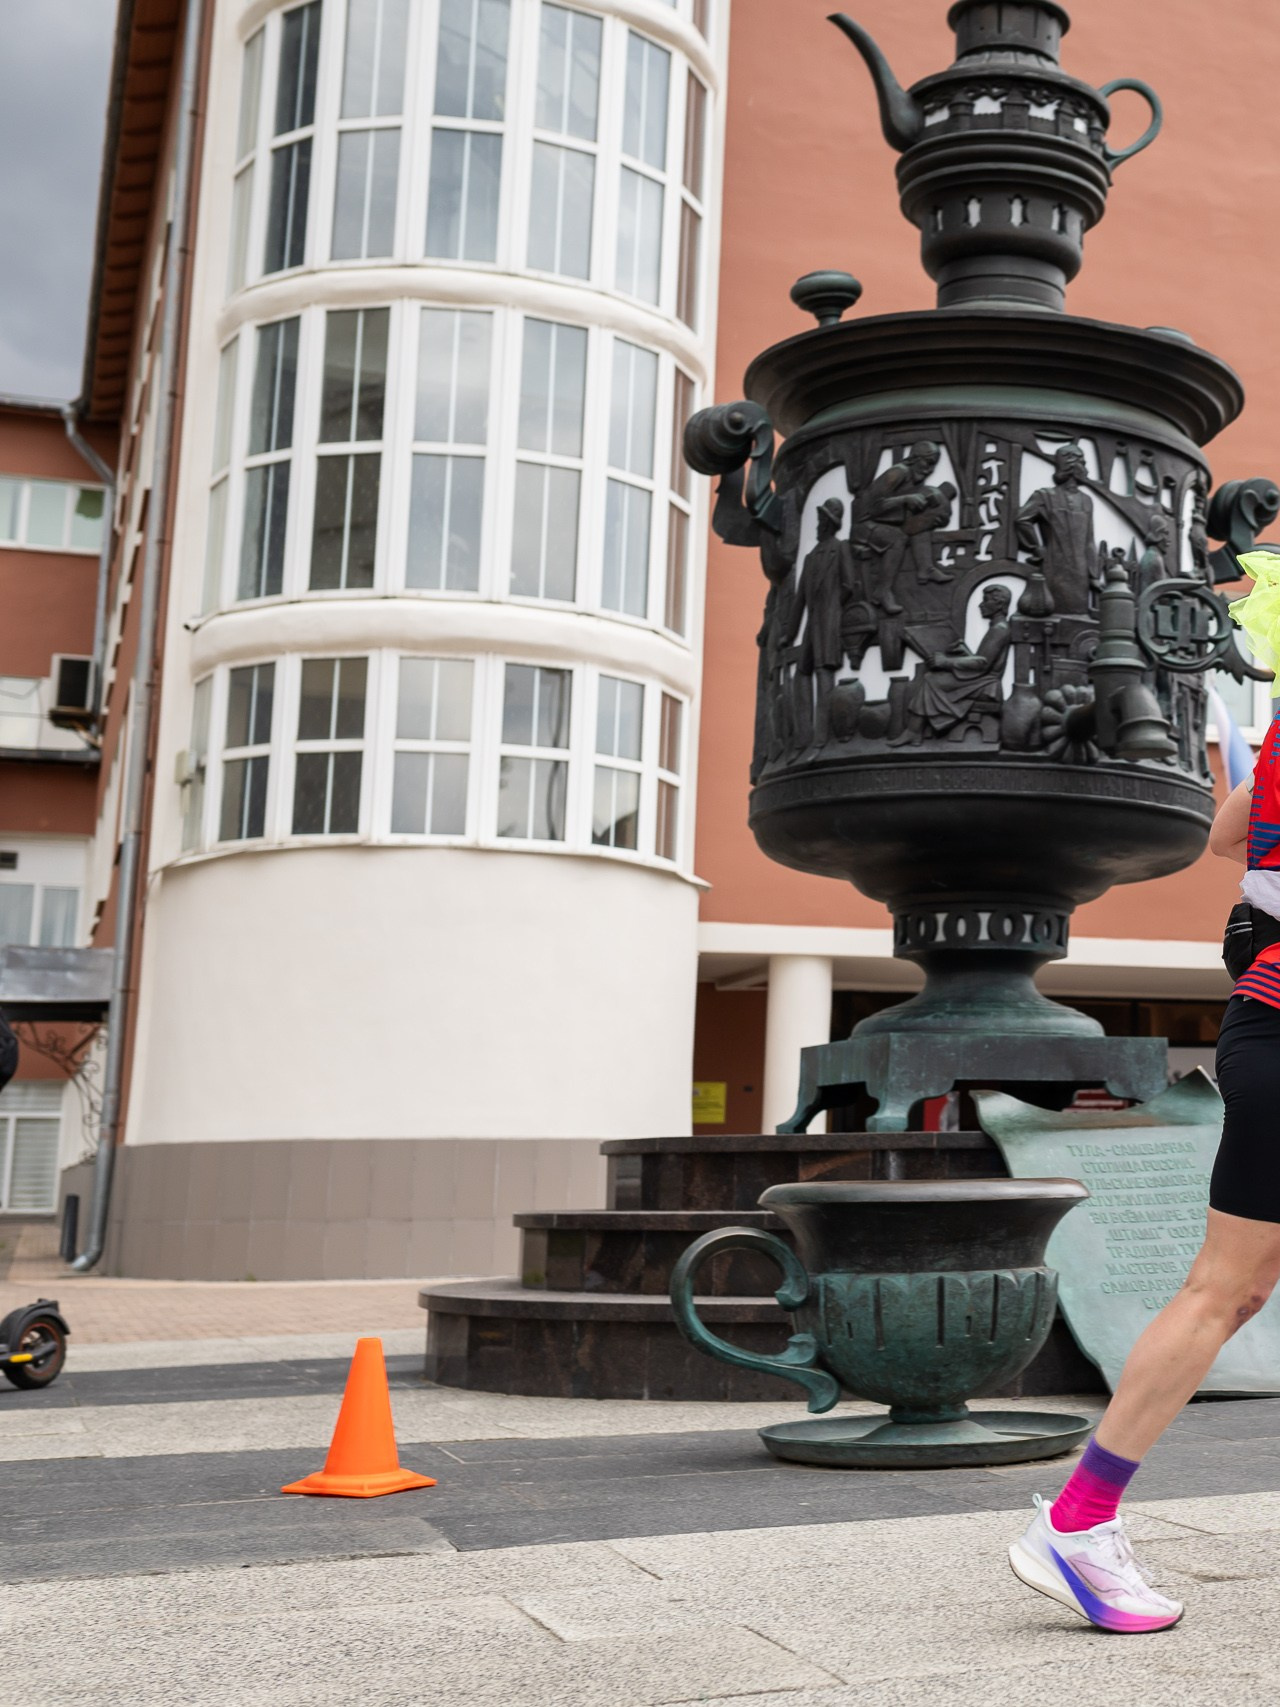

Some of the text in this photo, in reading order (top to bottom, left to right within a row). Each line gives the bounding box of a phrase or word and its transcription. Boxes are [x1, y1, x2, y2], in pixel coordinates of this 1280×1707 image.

[1081, 1160, 1143, 1174] СТОЛИЦА
[1153, 1189, 1209, 1205] ПРИЗНА
[1101, 1277, 1186, 1294] САМОВАРНО
